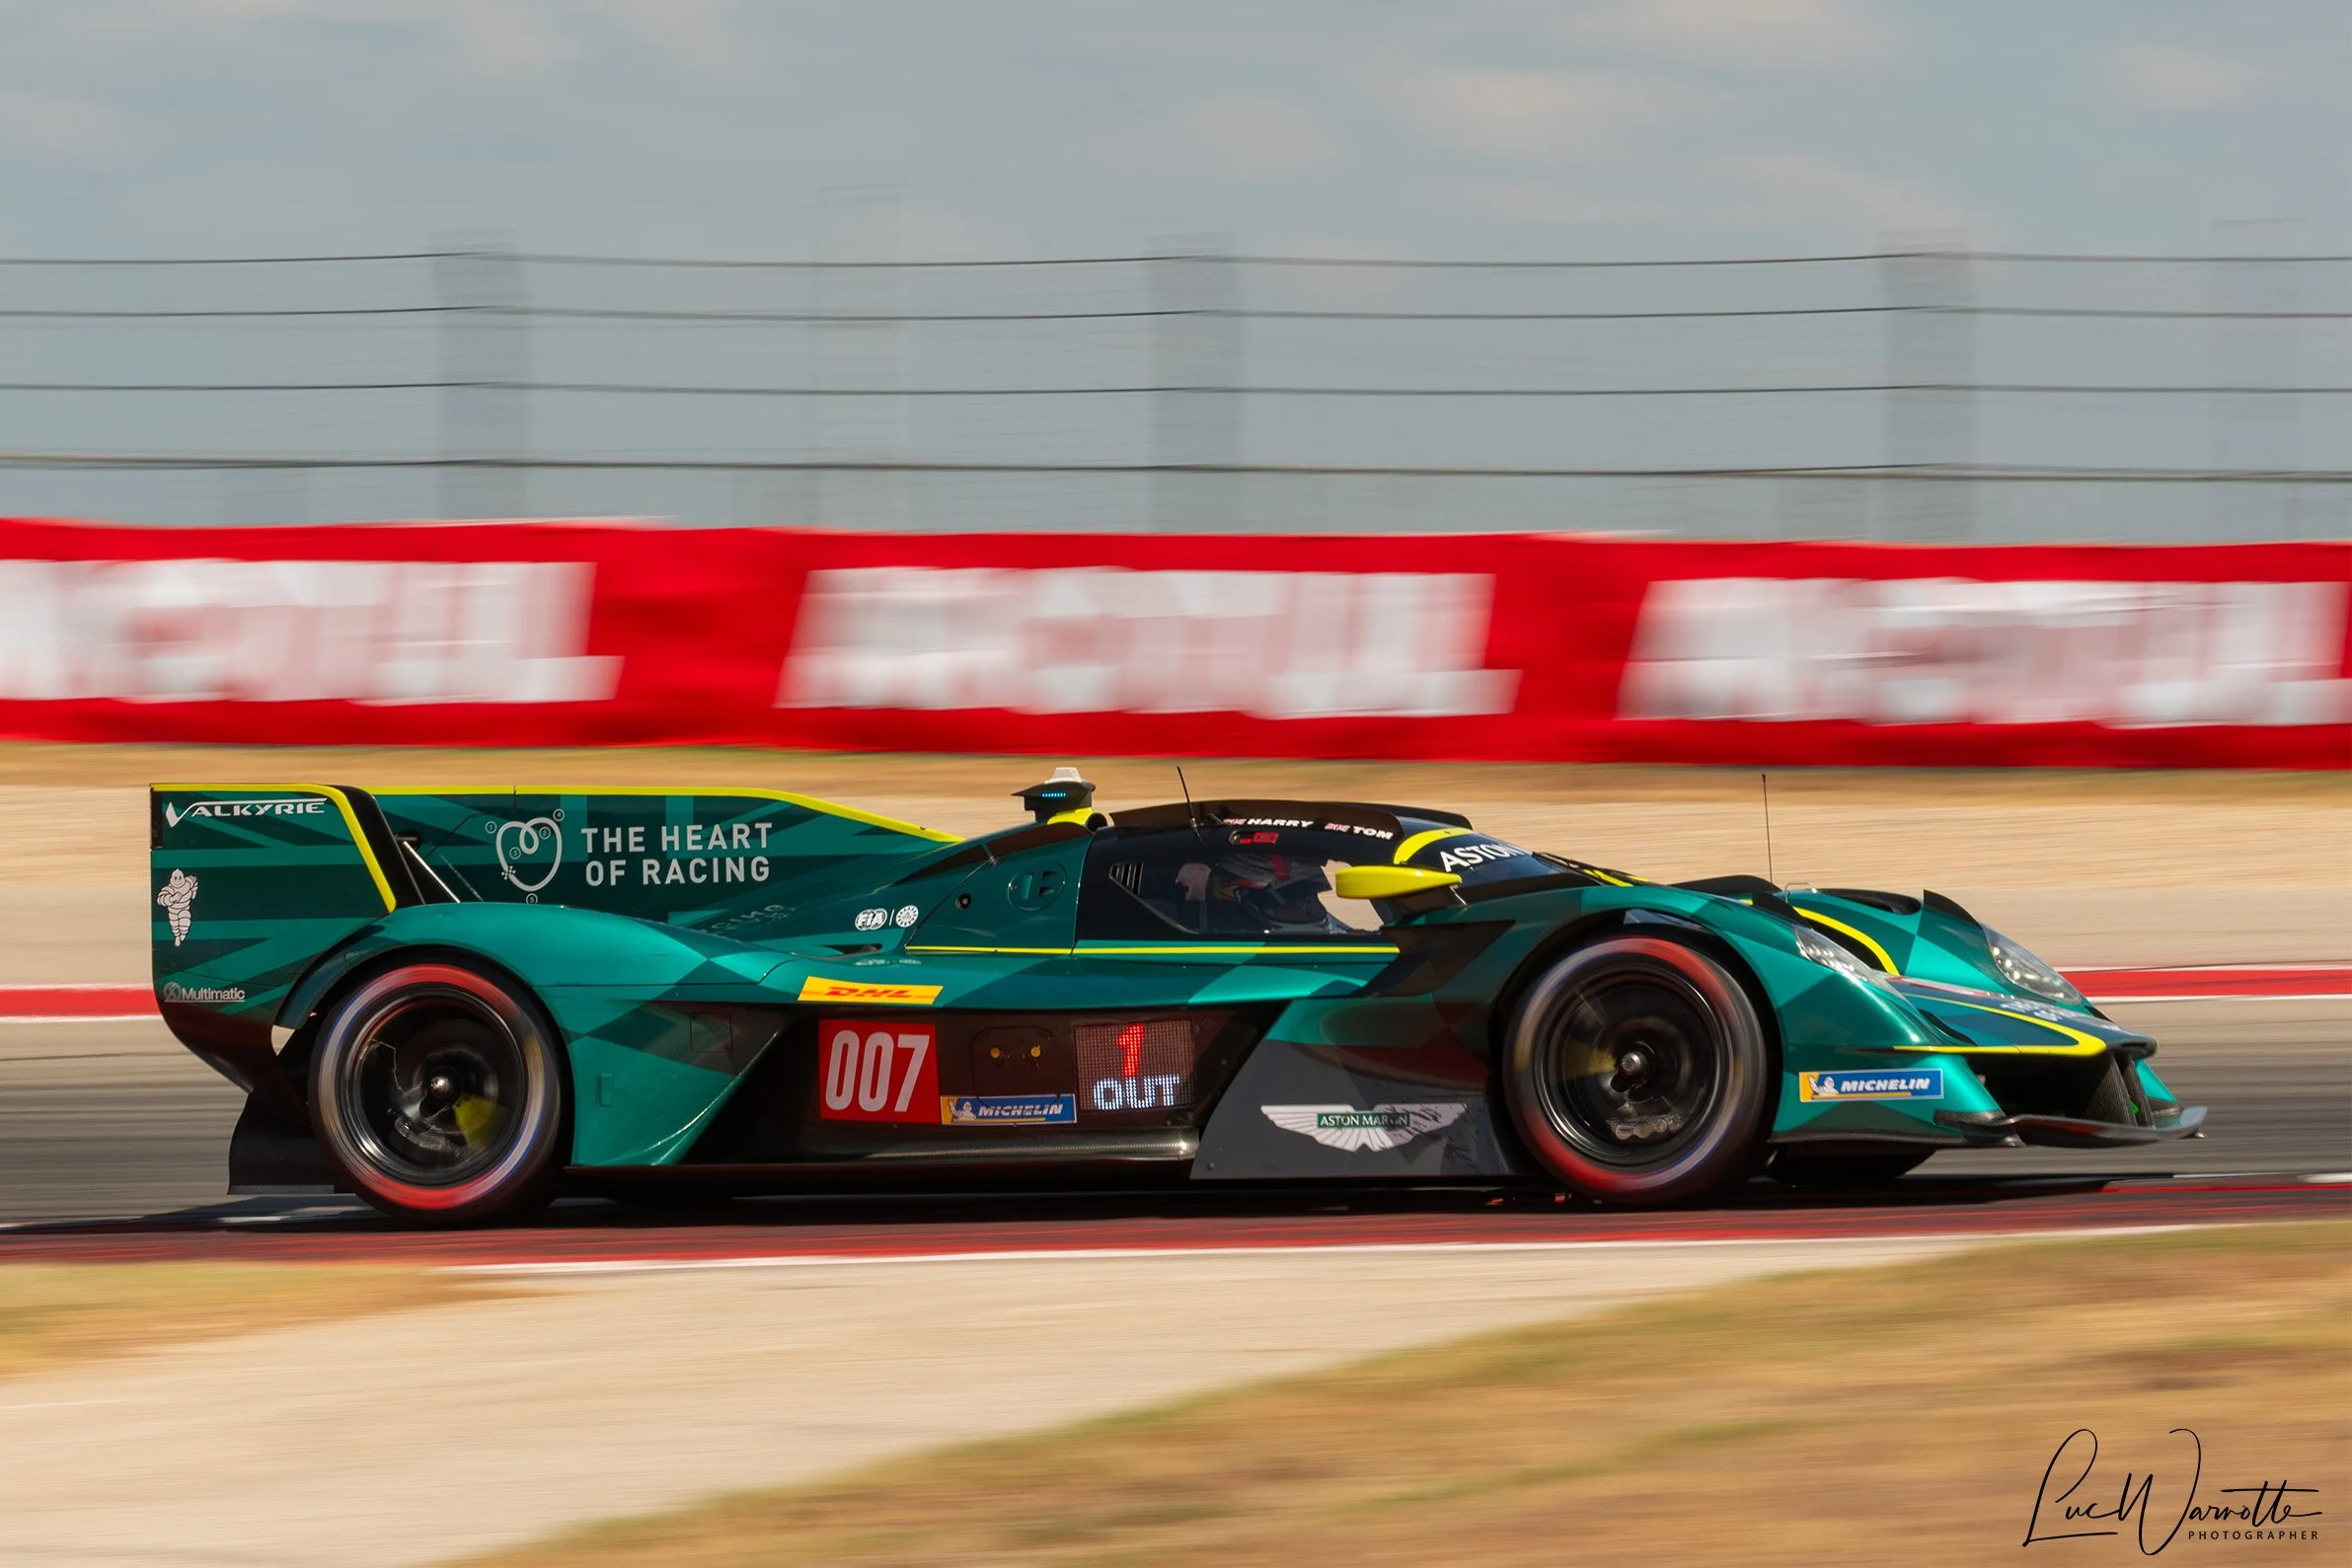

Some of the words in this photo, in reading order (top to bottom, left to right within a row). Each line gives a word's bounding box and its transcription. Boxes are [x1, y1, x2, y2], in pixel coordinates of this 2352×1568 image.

[166, 797, 328, 828] VALKYRIE
[1247, 818, 1315, 828] HARRY
[580, 827, 645, 854] THE
[661, 822, 773, 852] HEART
[1352, 826, 1394, 840] TOM
[1439, 843, 1526, 872] ASTON
[585, 859, 627, 886] OF
[643, 856, 770, 885] RACING
[182, 988, 246, 1000] Multimatic
[825, 987, 911, 999] DHL
[1116, 1022, 1144, 1078] 1
[825, 1029, 930, 1113] 007
[1094, 1074, 1180, 1110] OUT
[1841, 1078, 1931, 1092] MICHELIN
[978, 1104, 1064, 1116] MICHELIN
[1320, 1114, 1359, 1126] ASTON
[1362, 1114, 1407, 1126] MARN
